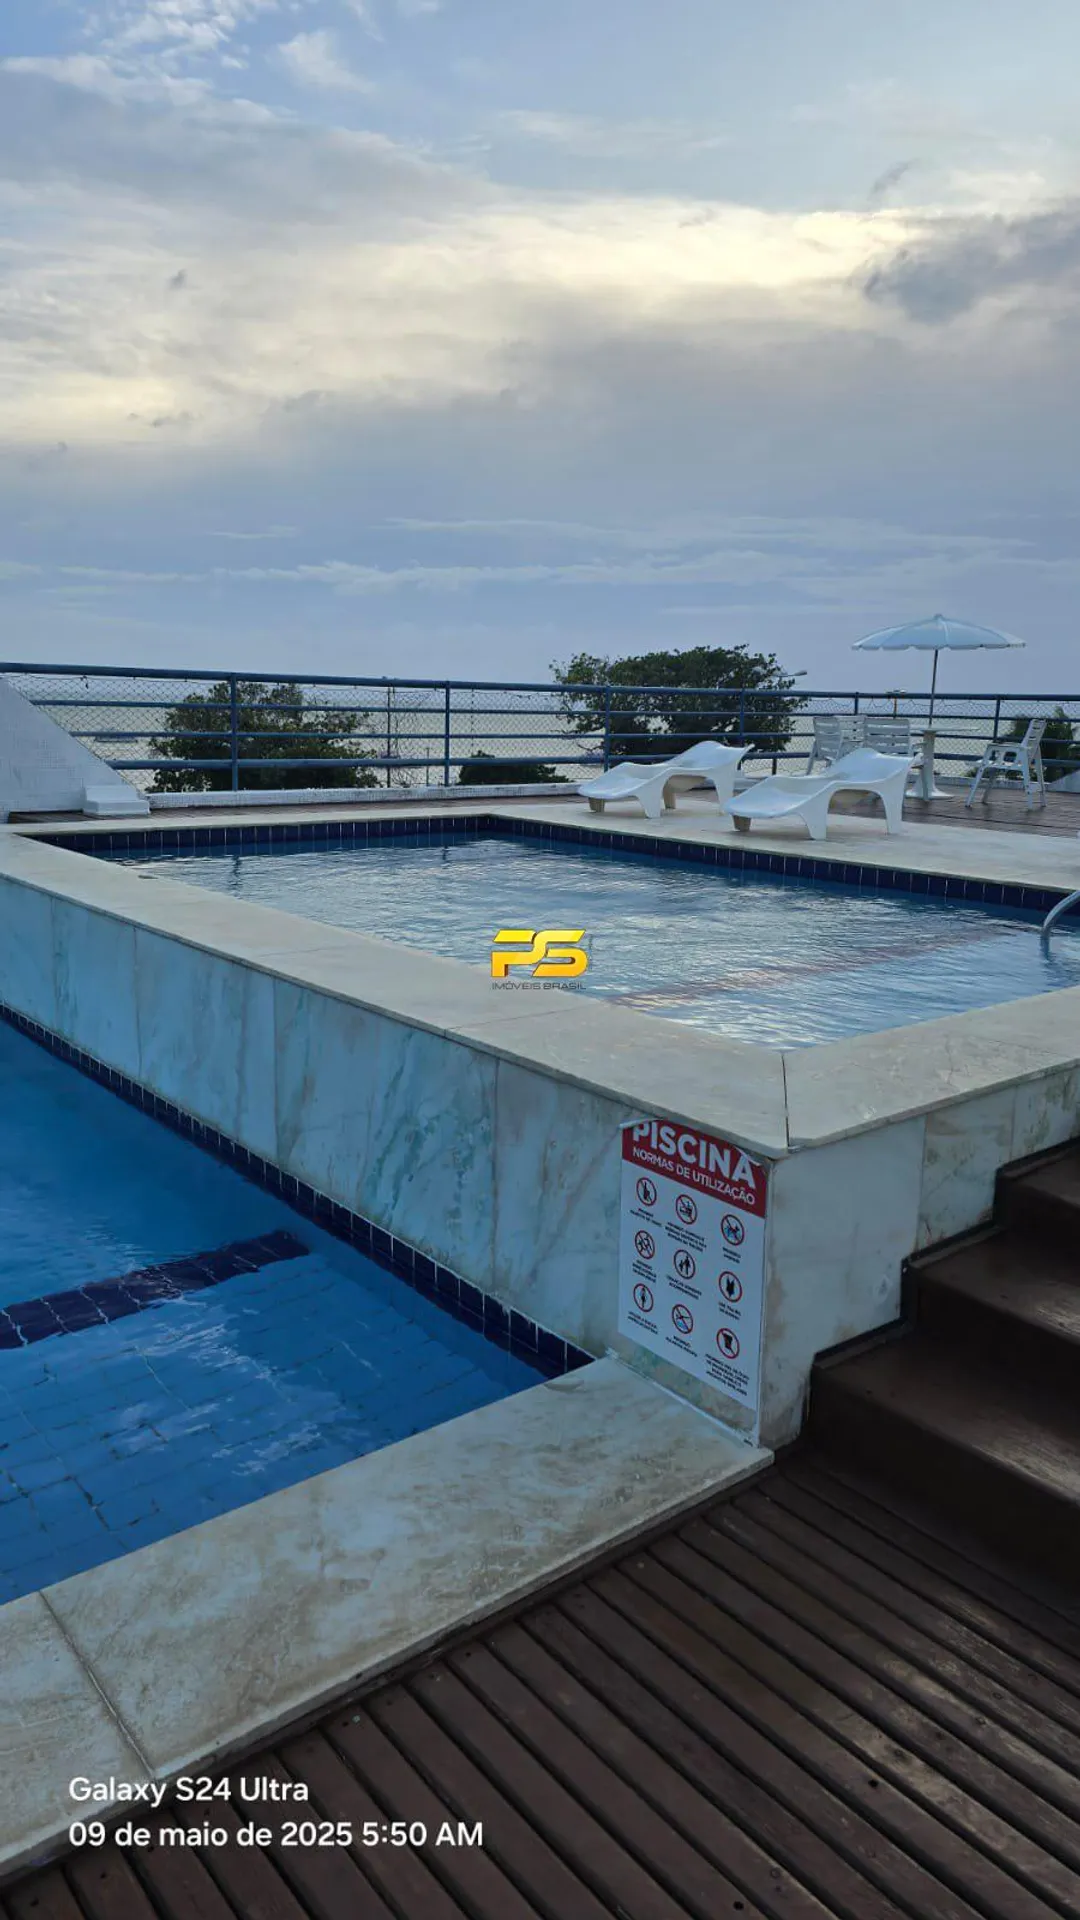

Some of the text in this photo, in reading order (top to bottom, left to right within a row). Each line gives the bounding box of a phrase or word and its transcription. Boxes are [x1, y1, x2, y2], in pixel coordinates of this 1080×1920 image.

[632, 1146, 756, 1206] NORMAS DE UTILIZAÇÃO
[633, 1122, 756, 1190] PISCINA
